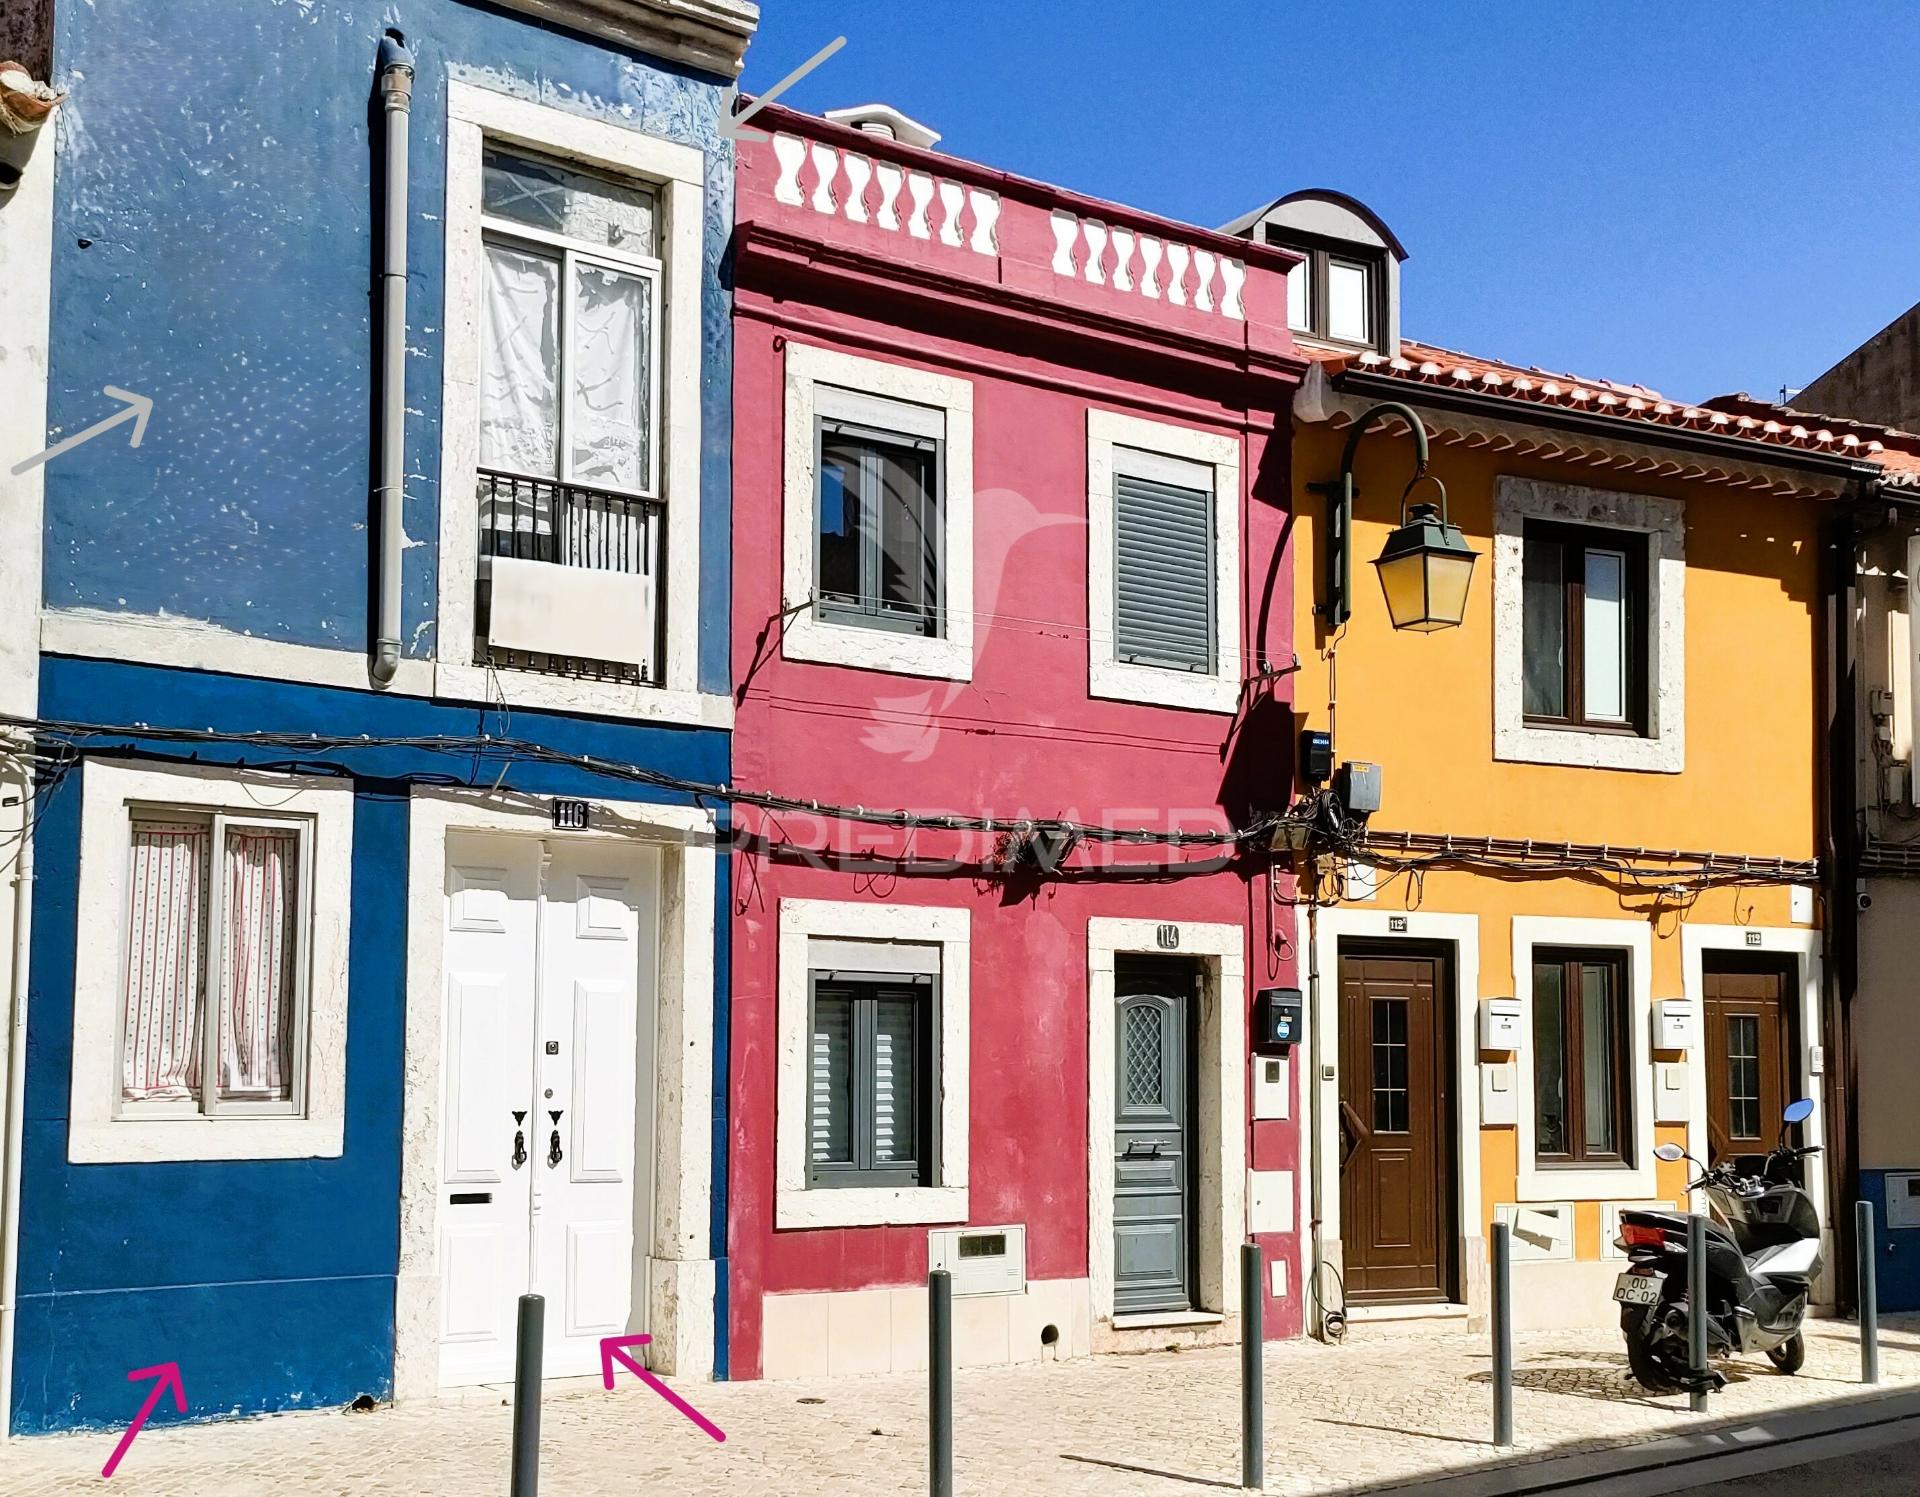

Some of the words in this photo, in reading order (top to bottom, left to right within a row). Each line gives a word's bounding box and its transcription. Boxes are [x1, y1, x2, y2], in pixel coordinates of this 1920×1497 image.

[558, 802, 584, 828] 116
[1160, 925, 1178, 948] 114
[1747, 933, 1761, 944] 112
